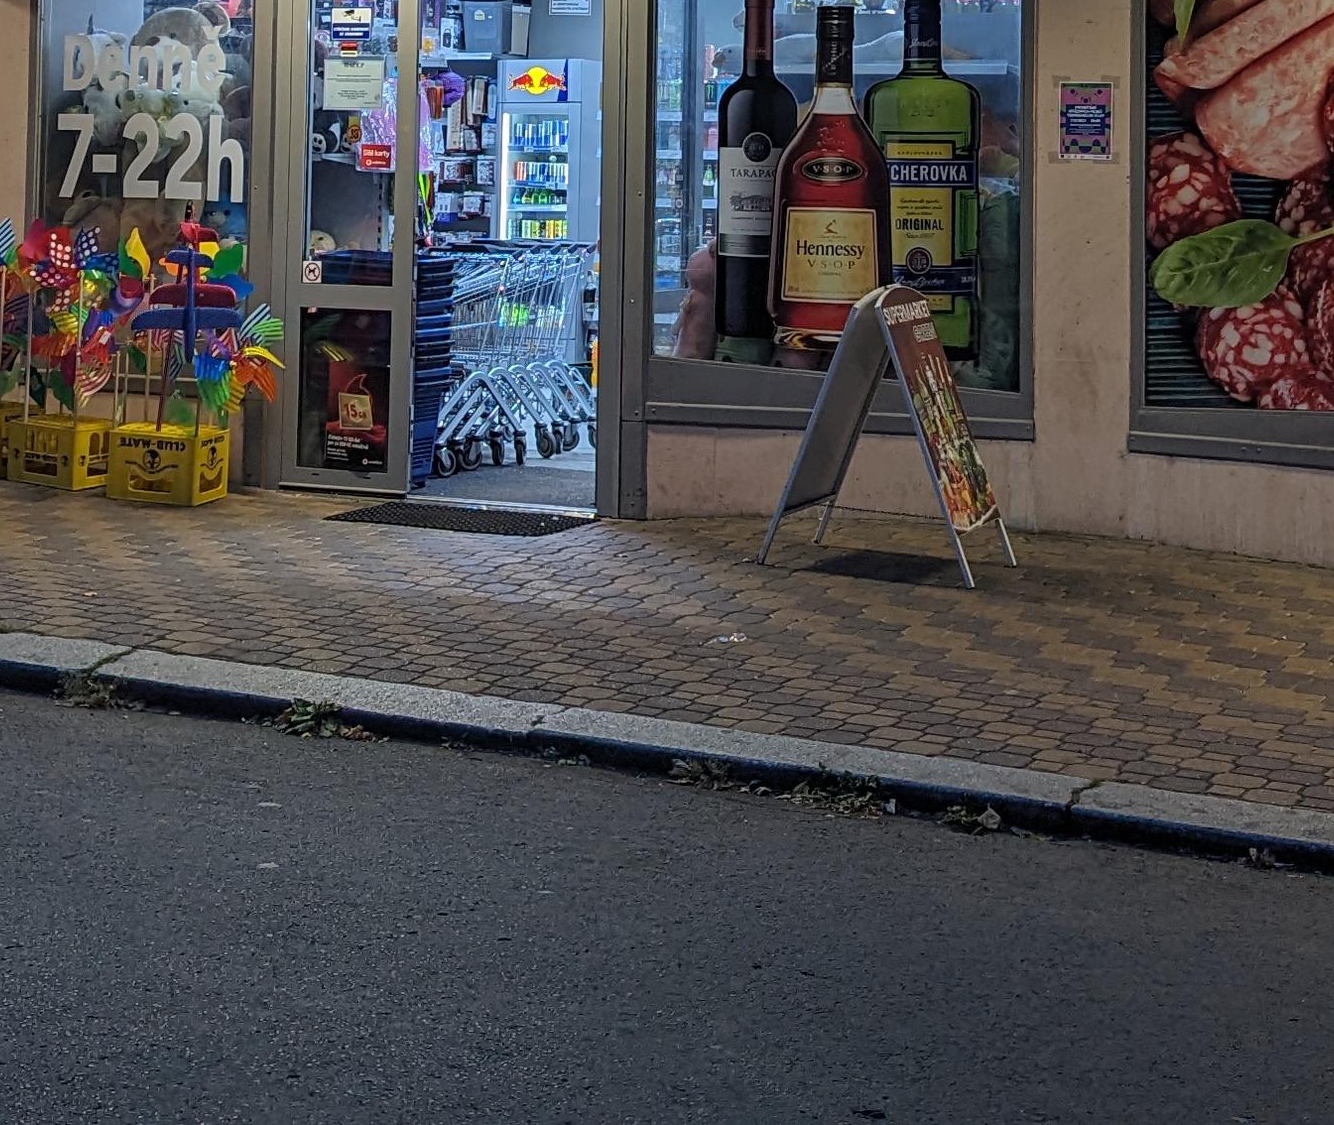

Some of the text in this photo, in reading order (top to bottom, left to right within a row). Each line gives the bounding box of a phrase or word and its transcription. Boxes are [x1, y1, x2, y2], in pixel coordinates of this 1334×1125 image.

[57, 113, 244, 204] 7-22h
[730, 168, 777, 179] TARAPAC
[889, 165, 968, 182] CHEROVKA
[895, 218, 944, 231] ORIGINAL
[796, 239, 865, 260] Hennessy
[120, 436, 186, 452] CLUB-MATE
